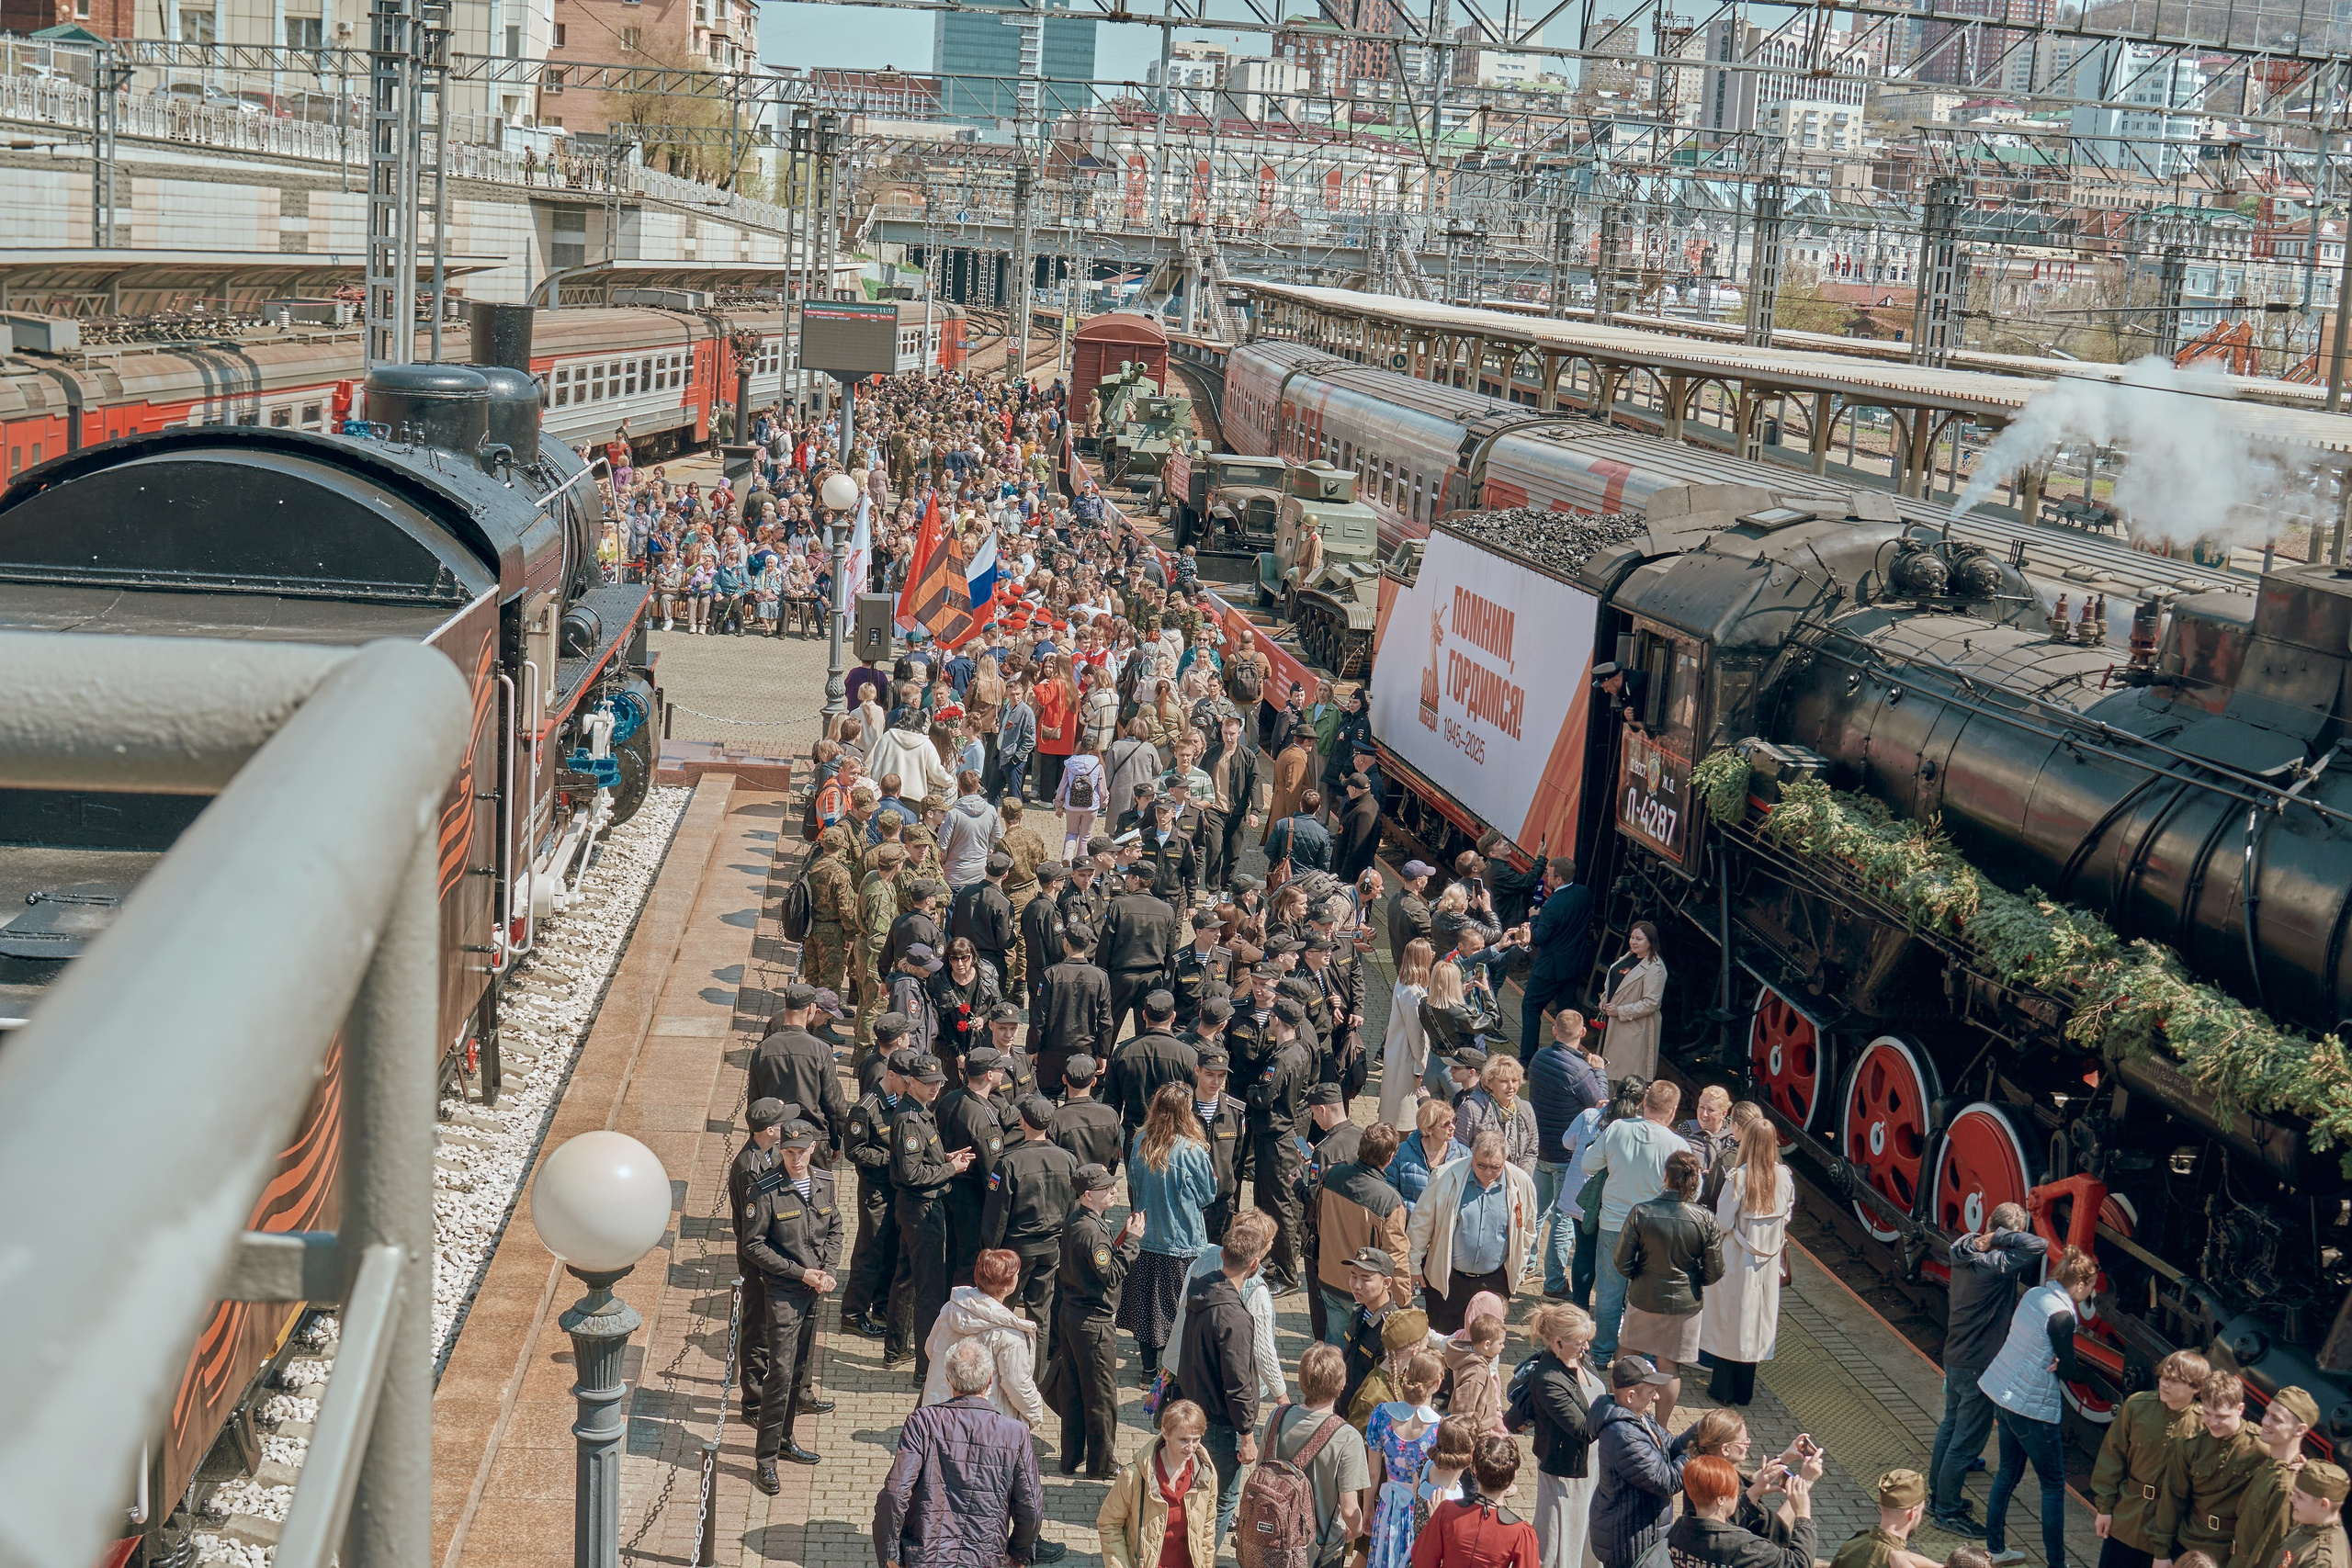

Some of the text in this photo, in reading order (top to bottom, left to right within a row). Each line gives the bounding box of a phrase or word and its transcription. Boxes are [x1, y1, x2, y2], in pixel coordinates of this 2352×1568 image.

[729, 464, 749, 478] 9288
[1452, 585, 1515, 674] ПОМНИМ,
[1420, 666, 1432, 703] 80
[1446, 649, 1525, 741] ГОРДИМСЯ!
[1419, 705, 1439, 733] ПОБЕДА!
[1662, 774, 1676, 794] Ж.Д.
[1625, 787, 1677, 846] Л-4287
